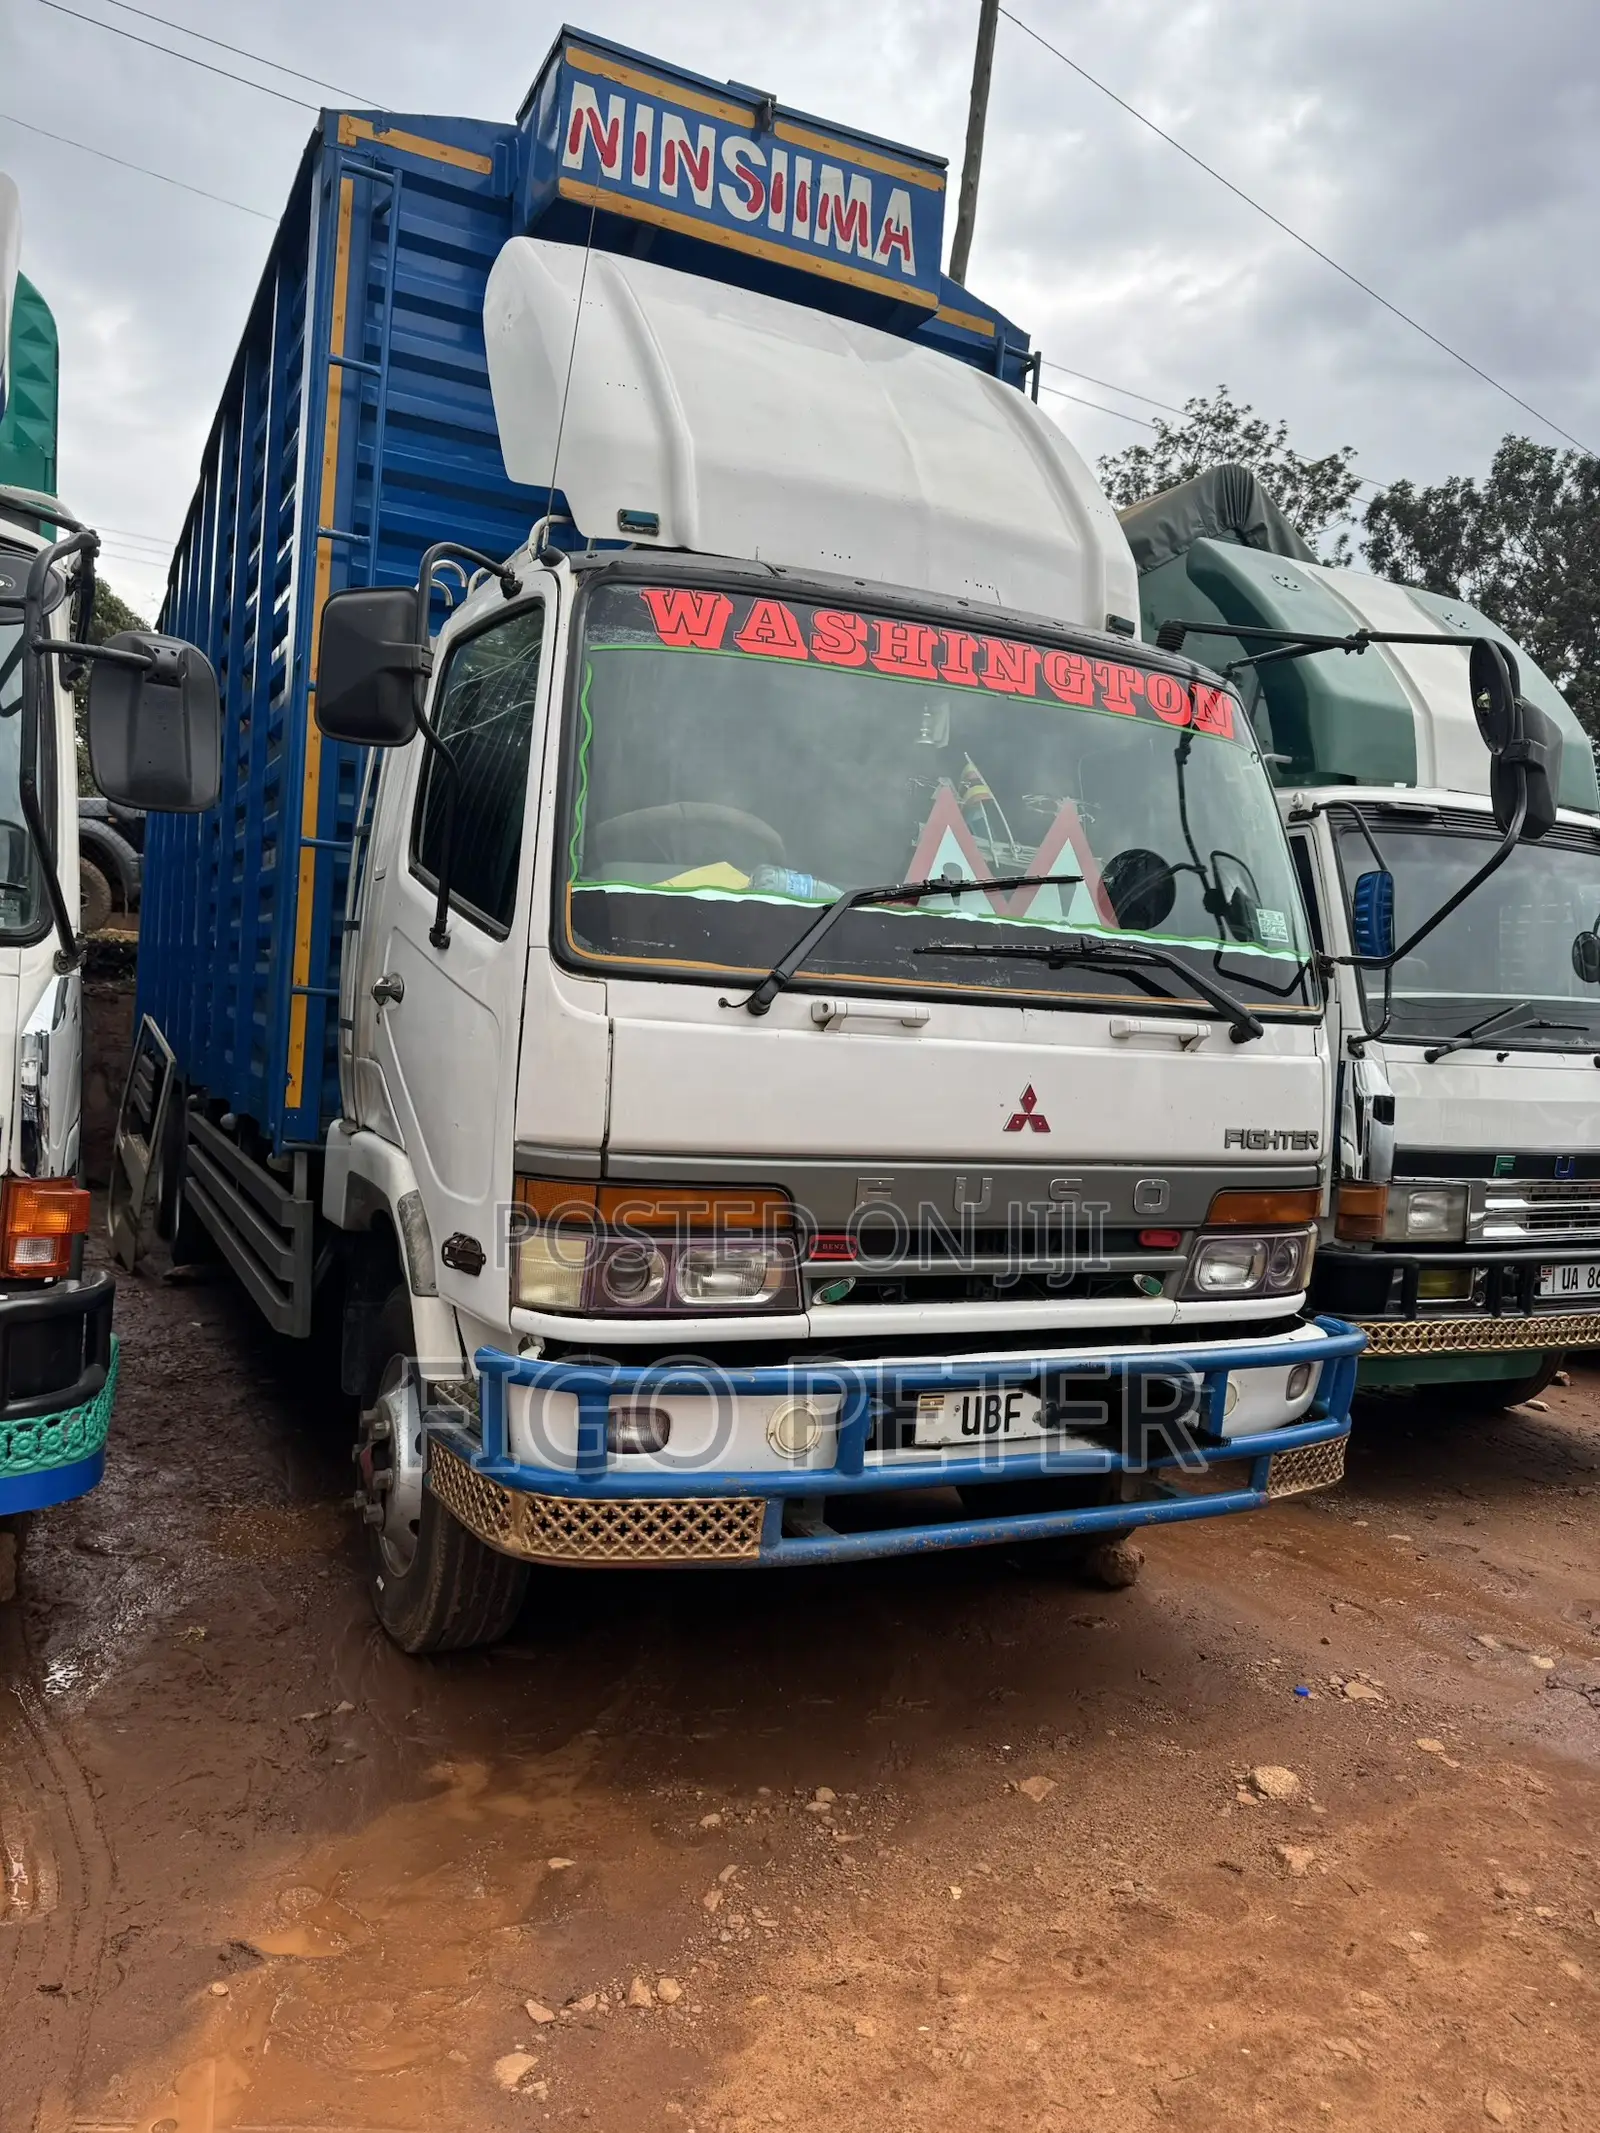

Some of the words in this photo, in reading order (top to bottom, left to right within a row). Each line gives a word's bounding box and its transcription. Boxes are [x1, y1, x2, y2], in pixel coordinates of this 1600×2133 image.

[562, 81, 916, 276] NINSIIMA
[641, 588, 1235, 739] WASHINGTON
[1224, 1128, 1319, 1150] FIGHTER
[855, 1177, 1171, 1215] FUSO
[961, 1392, 1024, 1436] UBF
